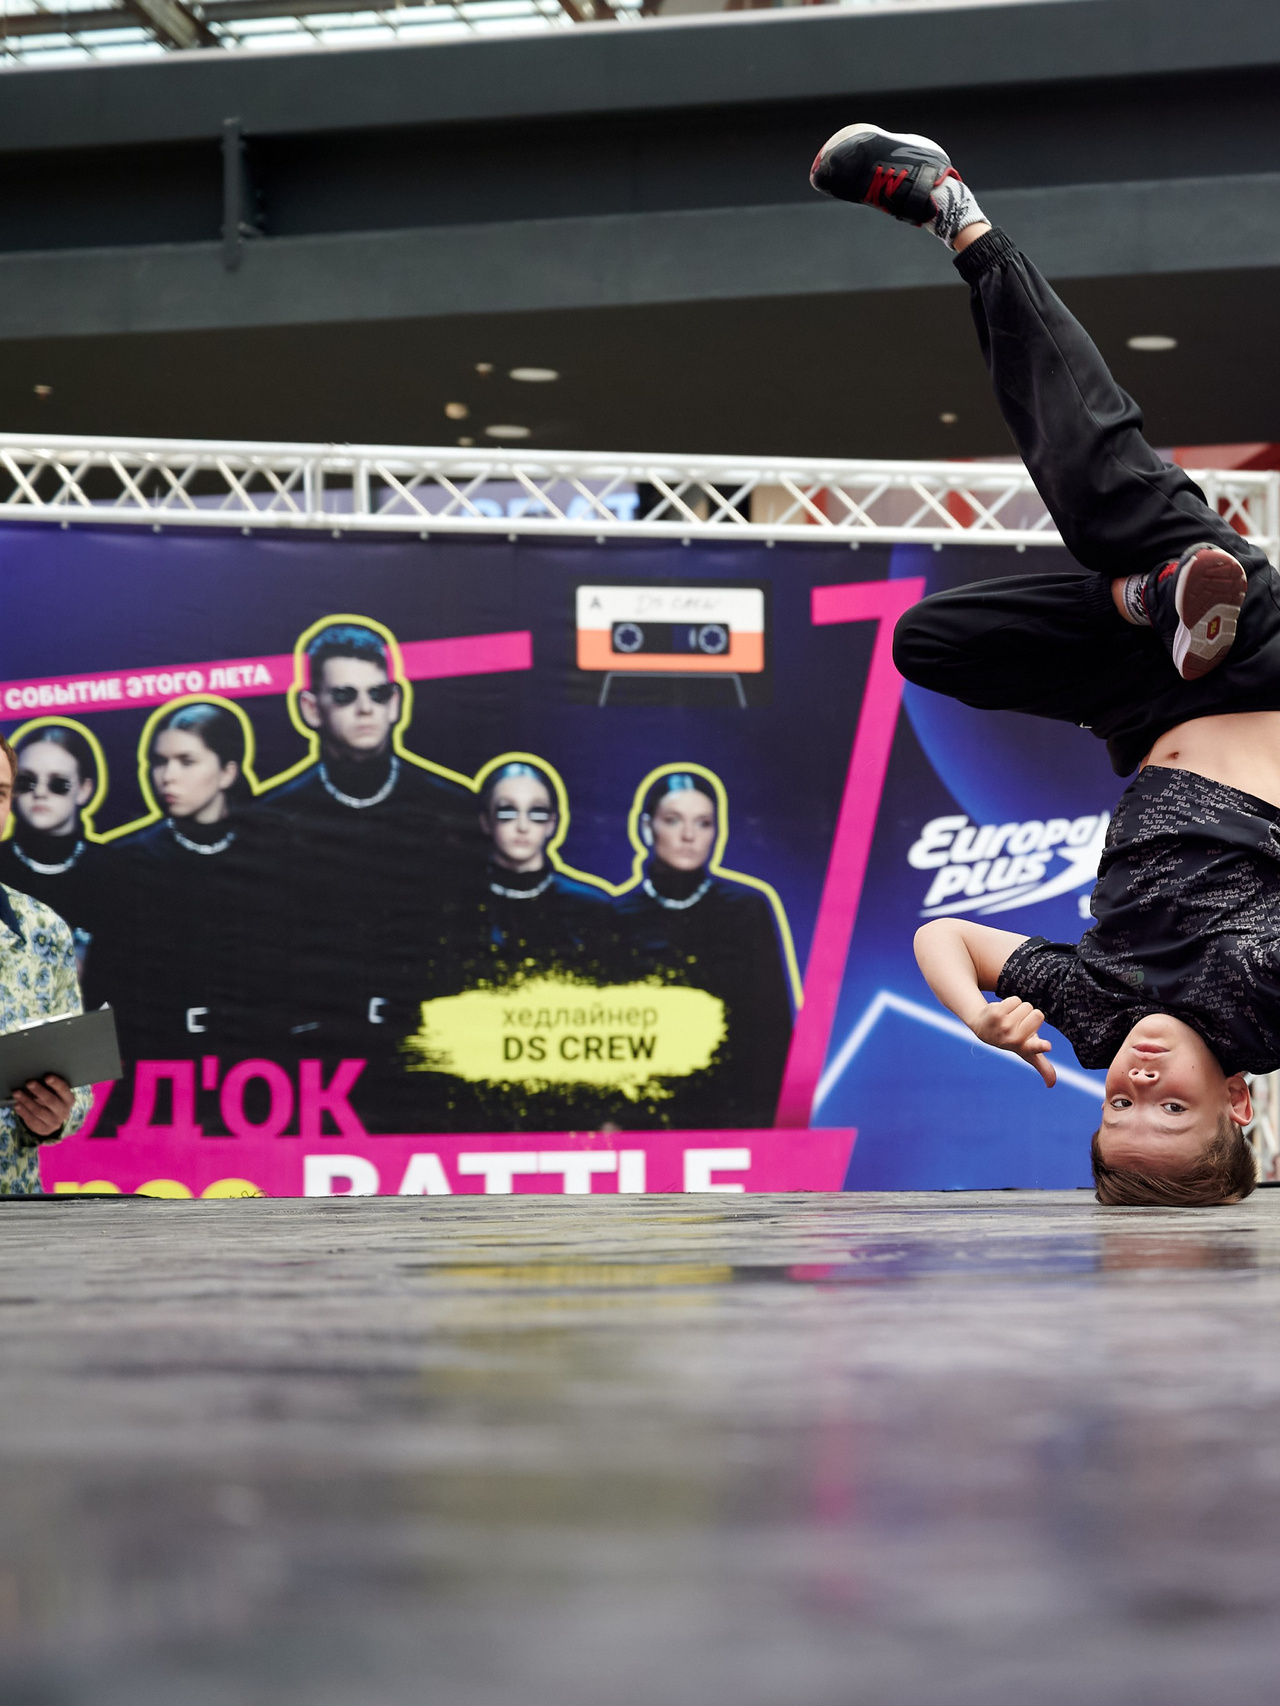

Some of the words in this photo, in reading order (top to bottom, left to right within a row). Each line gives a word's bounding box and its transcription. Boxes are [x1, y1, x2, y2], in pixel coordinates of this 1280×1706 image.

[5, 678, 122, 710] СОБЫТИЕ
[126, 670, 203, 698] ЭТОГО
[209, 663, 272, 690] ЛЕТА
[502, 1003, 659, 1030] хедлайнер
[503, 1036, 547, 1062] DS
[560, 1036, 657, 1062] CREW
